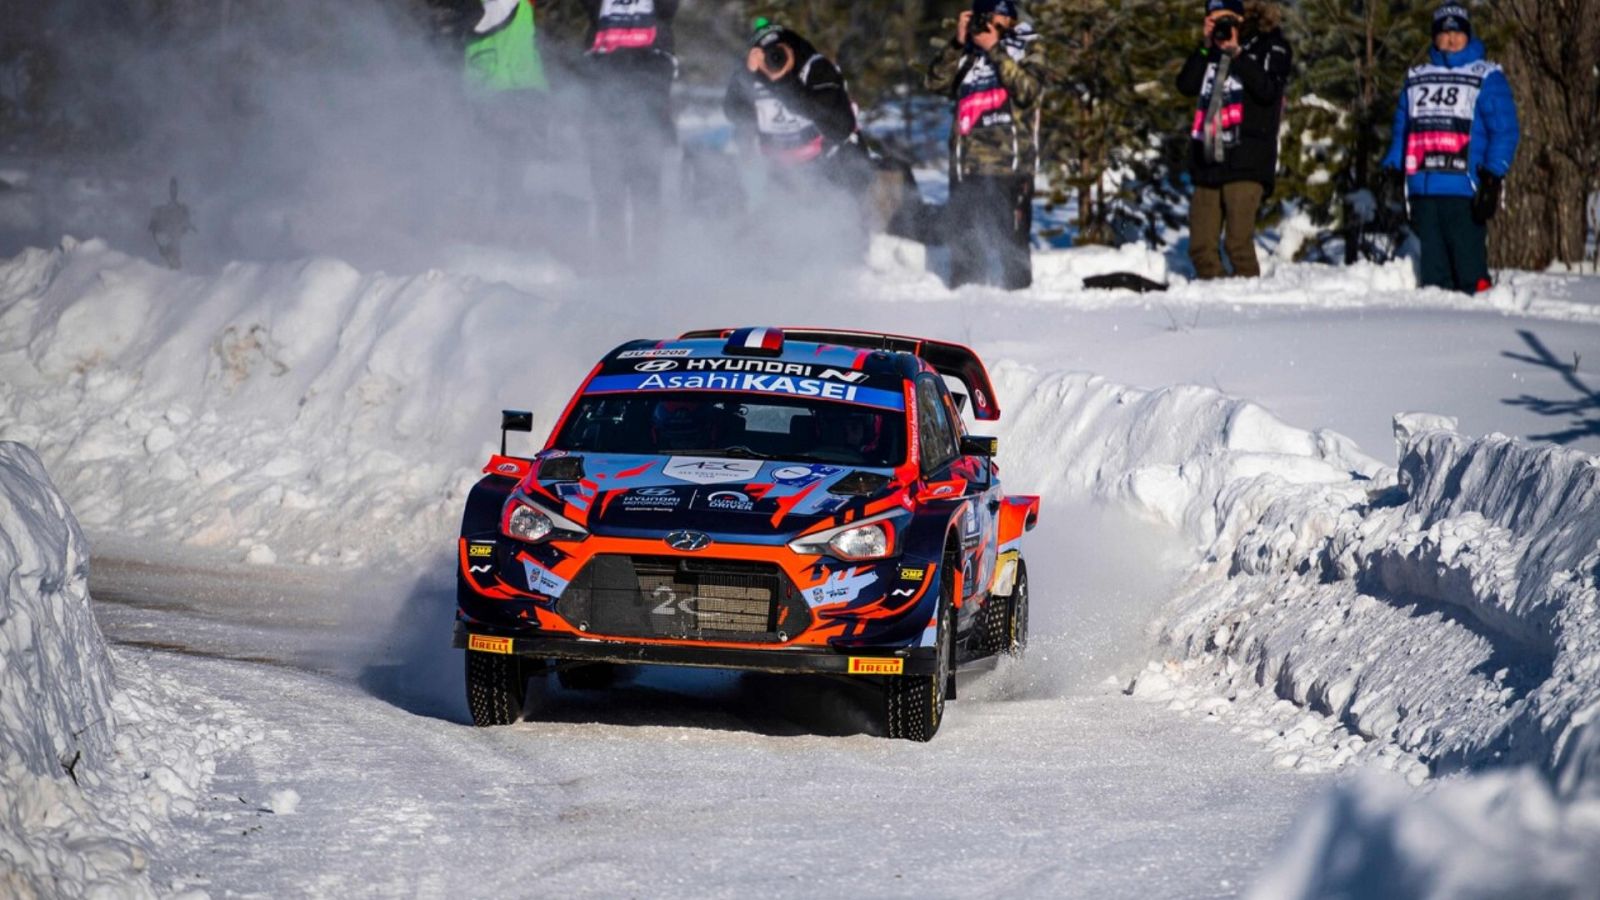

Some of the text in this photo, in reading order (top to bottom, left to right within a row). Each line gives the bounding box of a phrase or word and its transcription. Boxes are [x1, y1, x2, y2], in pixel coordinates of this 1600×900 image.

[1416, 86, 1459, 107] 248
[686, 359, 811, 376] HYUNDAI
[709, 502, 753, 510] DRIVER
[470, 547, 491, 555] OMP
[901, 570, 923, 579] OMP
[471, 635, 509, 653] PIRELLI
[853, 658, 900, 672] PIRELLI
